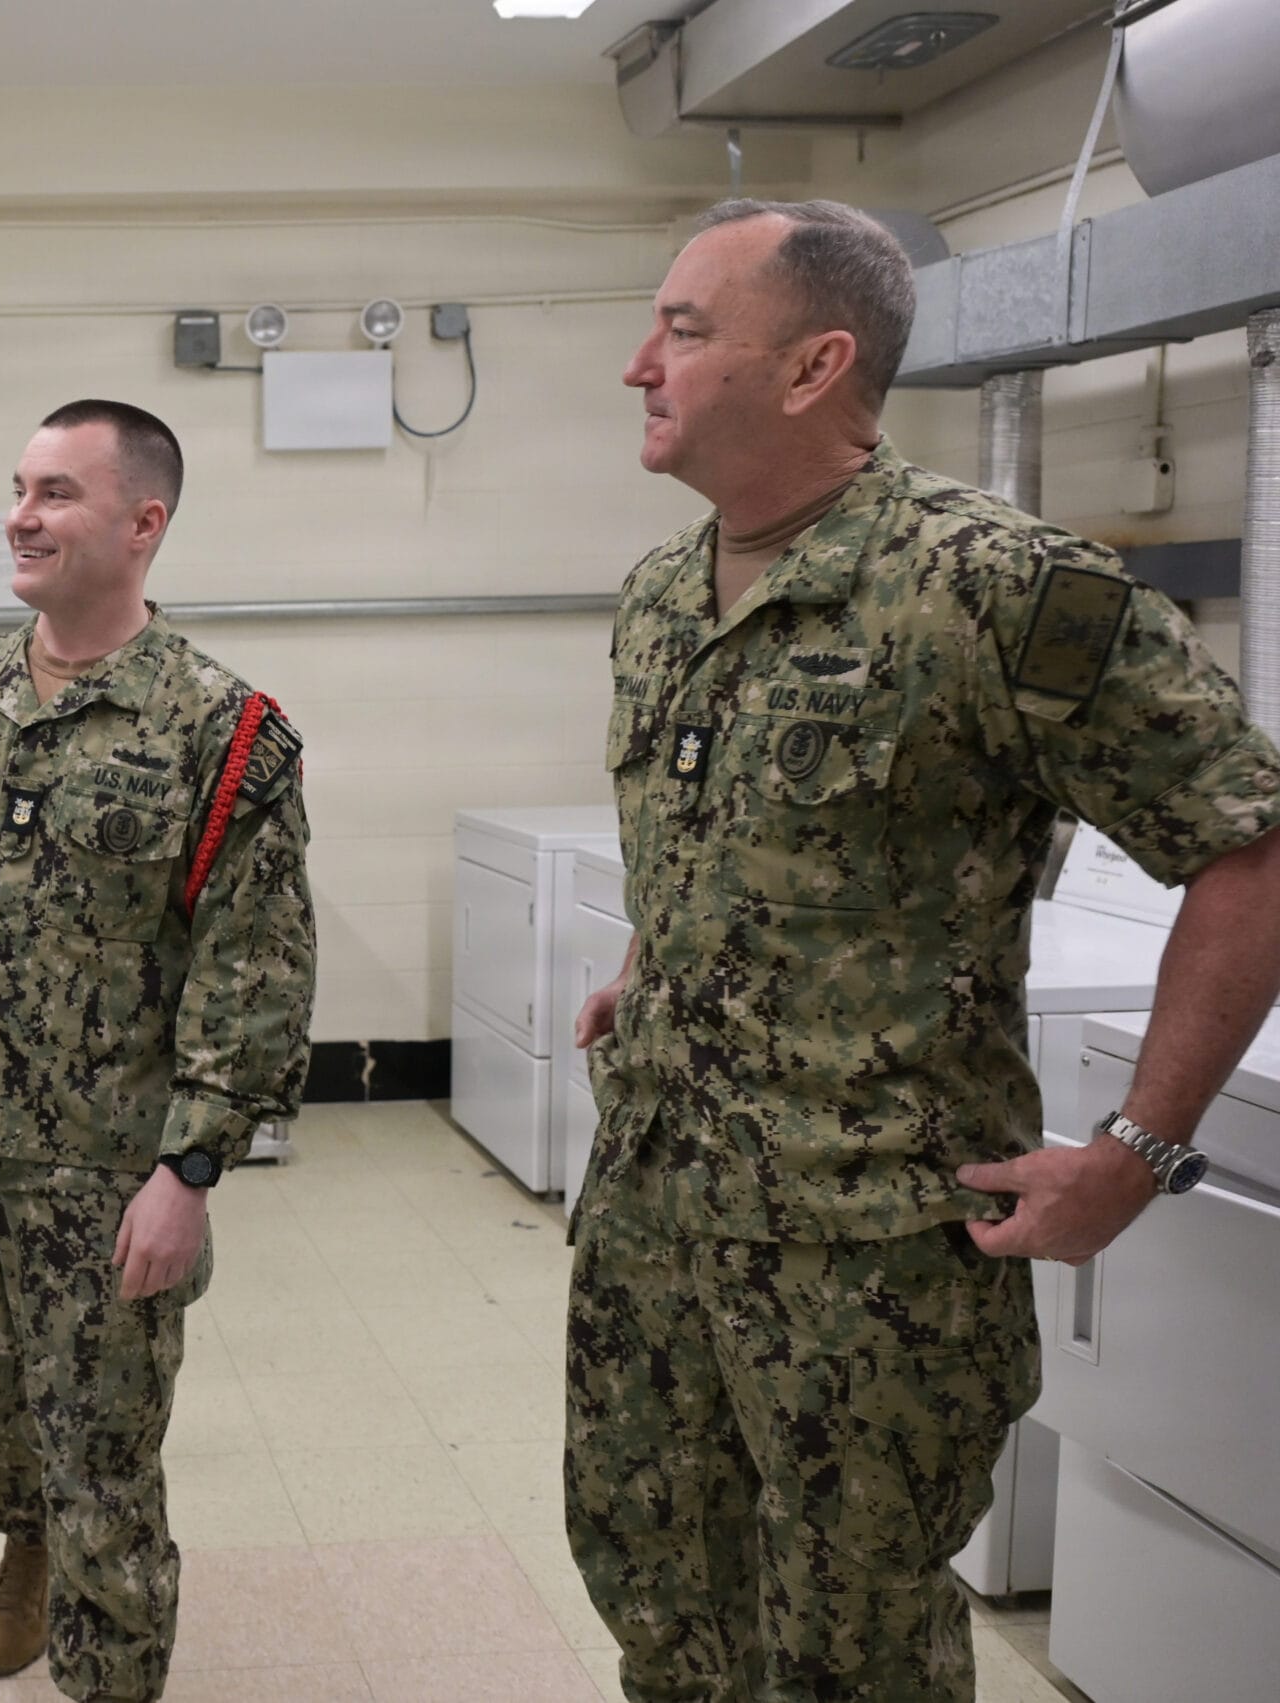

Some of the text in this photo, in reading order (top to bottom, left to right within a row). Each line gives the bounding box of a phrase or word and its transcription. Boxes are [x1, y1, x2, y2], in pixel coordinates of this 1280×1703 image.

[768, 687, 867, 718] U.S. NAVY
[94, 768, 172, 801] U.S. NAVY
